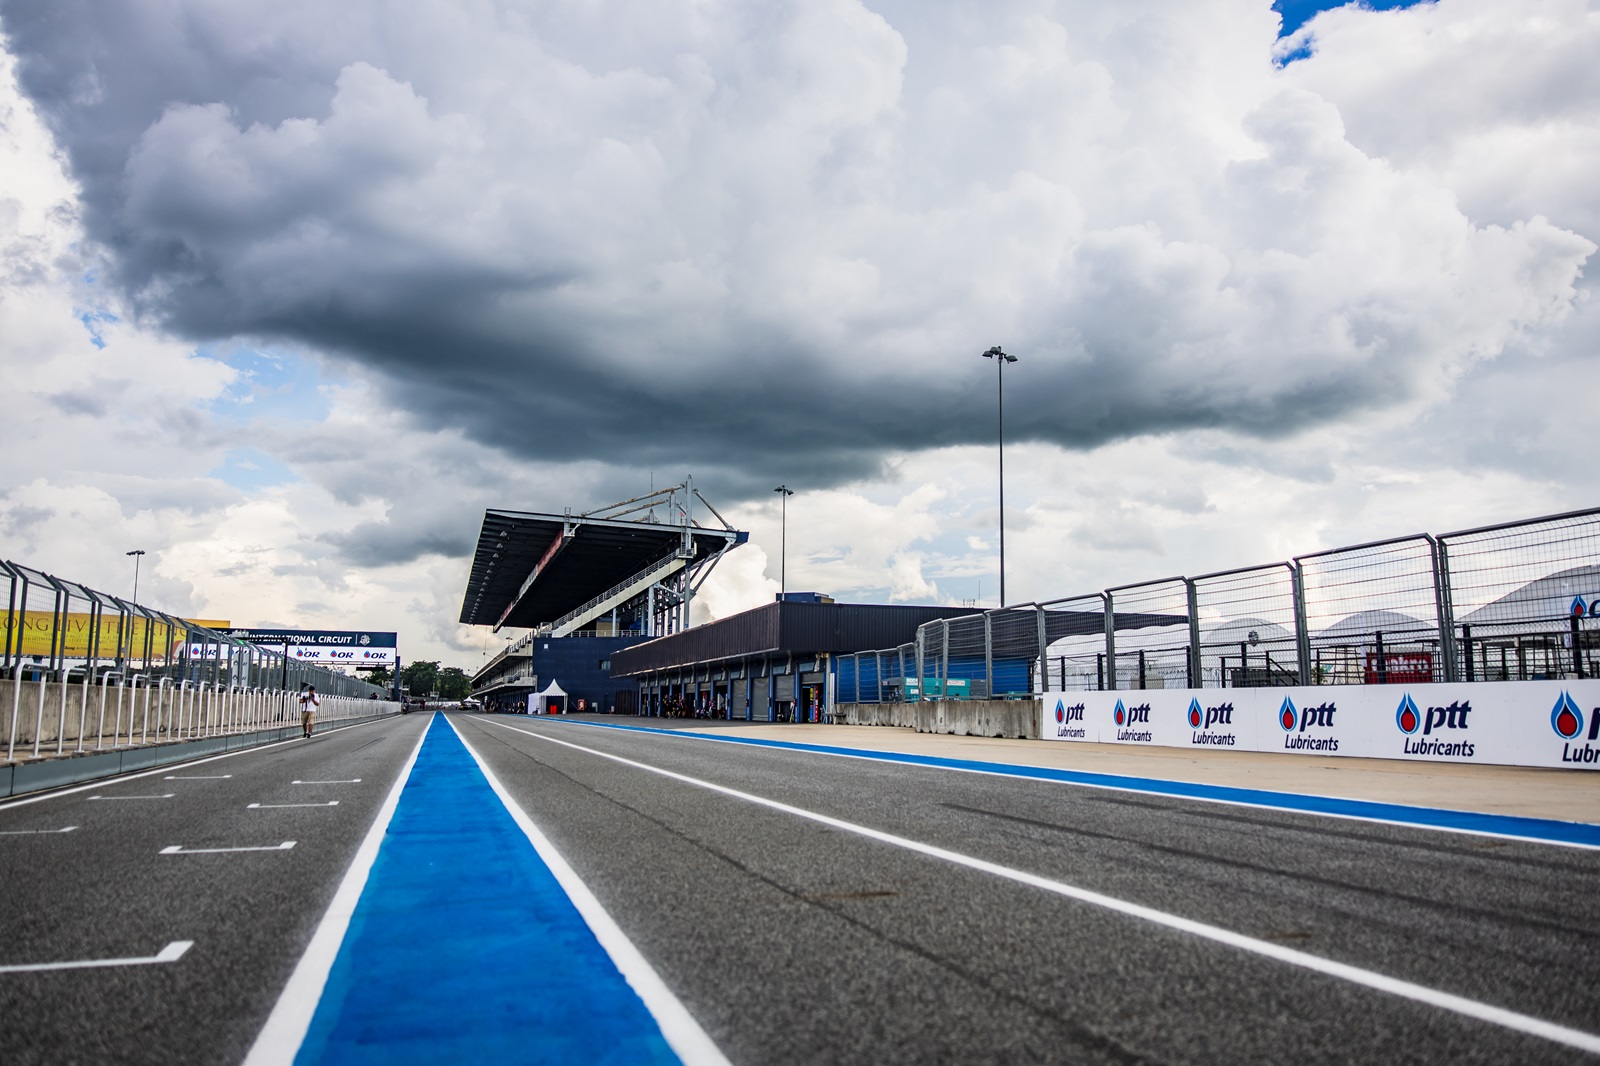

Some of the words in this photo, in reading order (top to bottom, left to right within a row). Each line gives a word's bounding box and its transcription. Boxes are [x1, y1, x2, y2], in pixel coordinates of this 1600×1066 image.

[0, 617, 49, 632] ONG
[318, 635, 353, 644] CIRCUIT
[337, 651, 354, 659] OR
[1066, 703, 1085, 725] ptt
[1127, 703, 1151, 727] ptt
[1204, 702, 1234, 730] ptt
[1299, 702, 1337, 733] ptt
[1423, 700, 1472, 735] ptt
[1057, 726, 1086, 739] Lubricants
[1117, 728, 1153, 742] Lubricants
[1192, 731, 1236, 747] Lubricants
[1284, 734, 1339, 752] Lubricants
[1403, 737, 1475, 757] Lubricants
